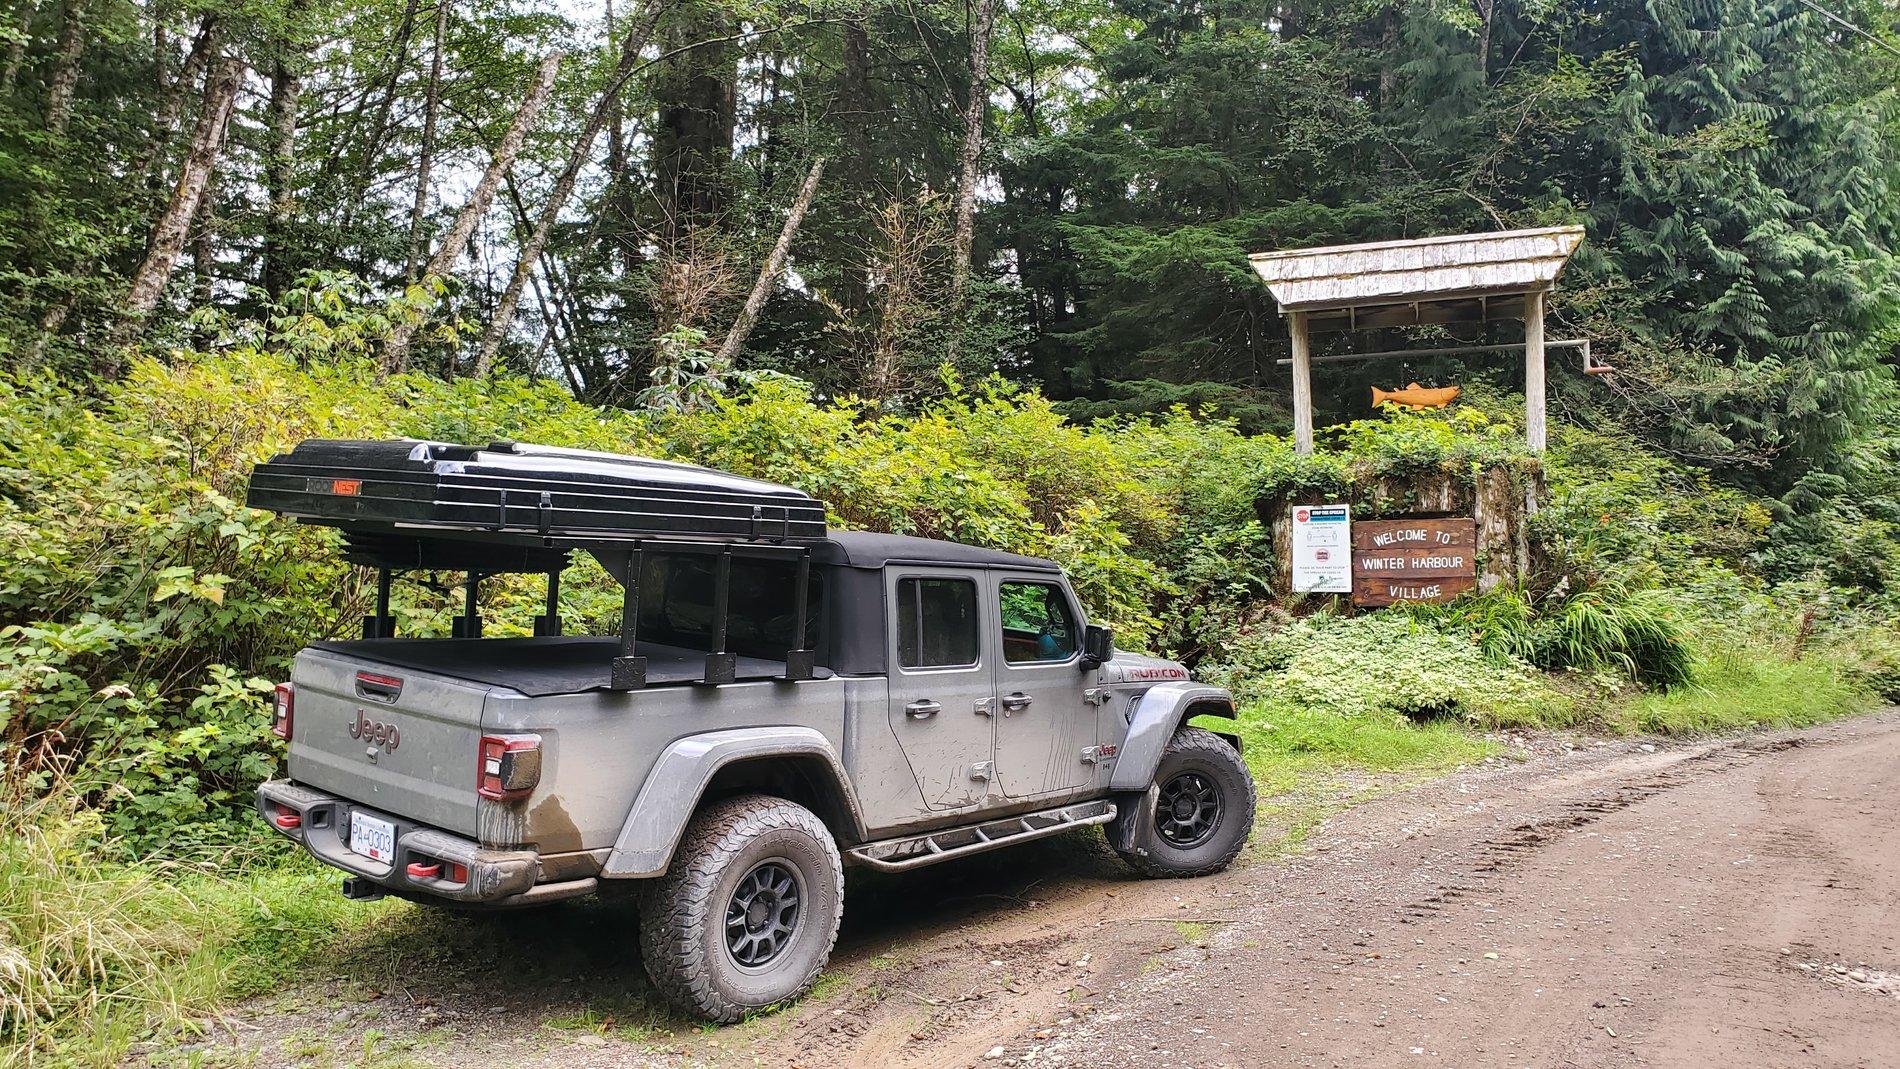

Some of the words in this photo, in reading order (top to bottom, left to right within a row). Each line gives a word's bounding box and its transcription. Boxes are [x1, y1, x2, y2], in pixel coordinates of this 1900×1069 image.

[1373, 529, 1427, 547] WELCOME
[1436, 531, 1450, 544] TO
[1362, 557, 1404, 570] WINTER
[1412, 556, 1463, 568] HARBOUR
[1390, 585, 1441, 599] VILLAGE
[1130, 668, 1185, 678] RUBICON
[349, 708, 400, 754] Jeep
